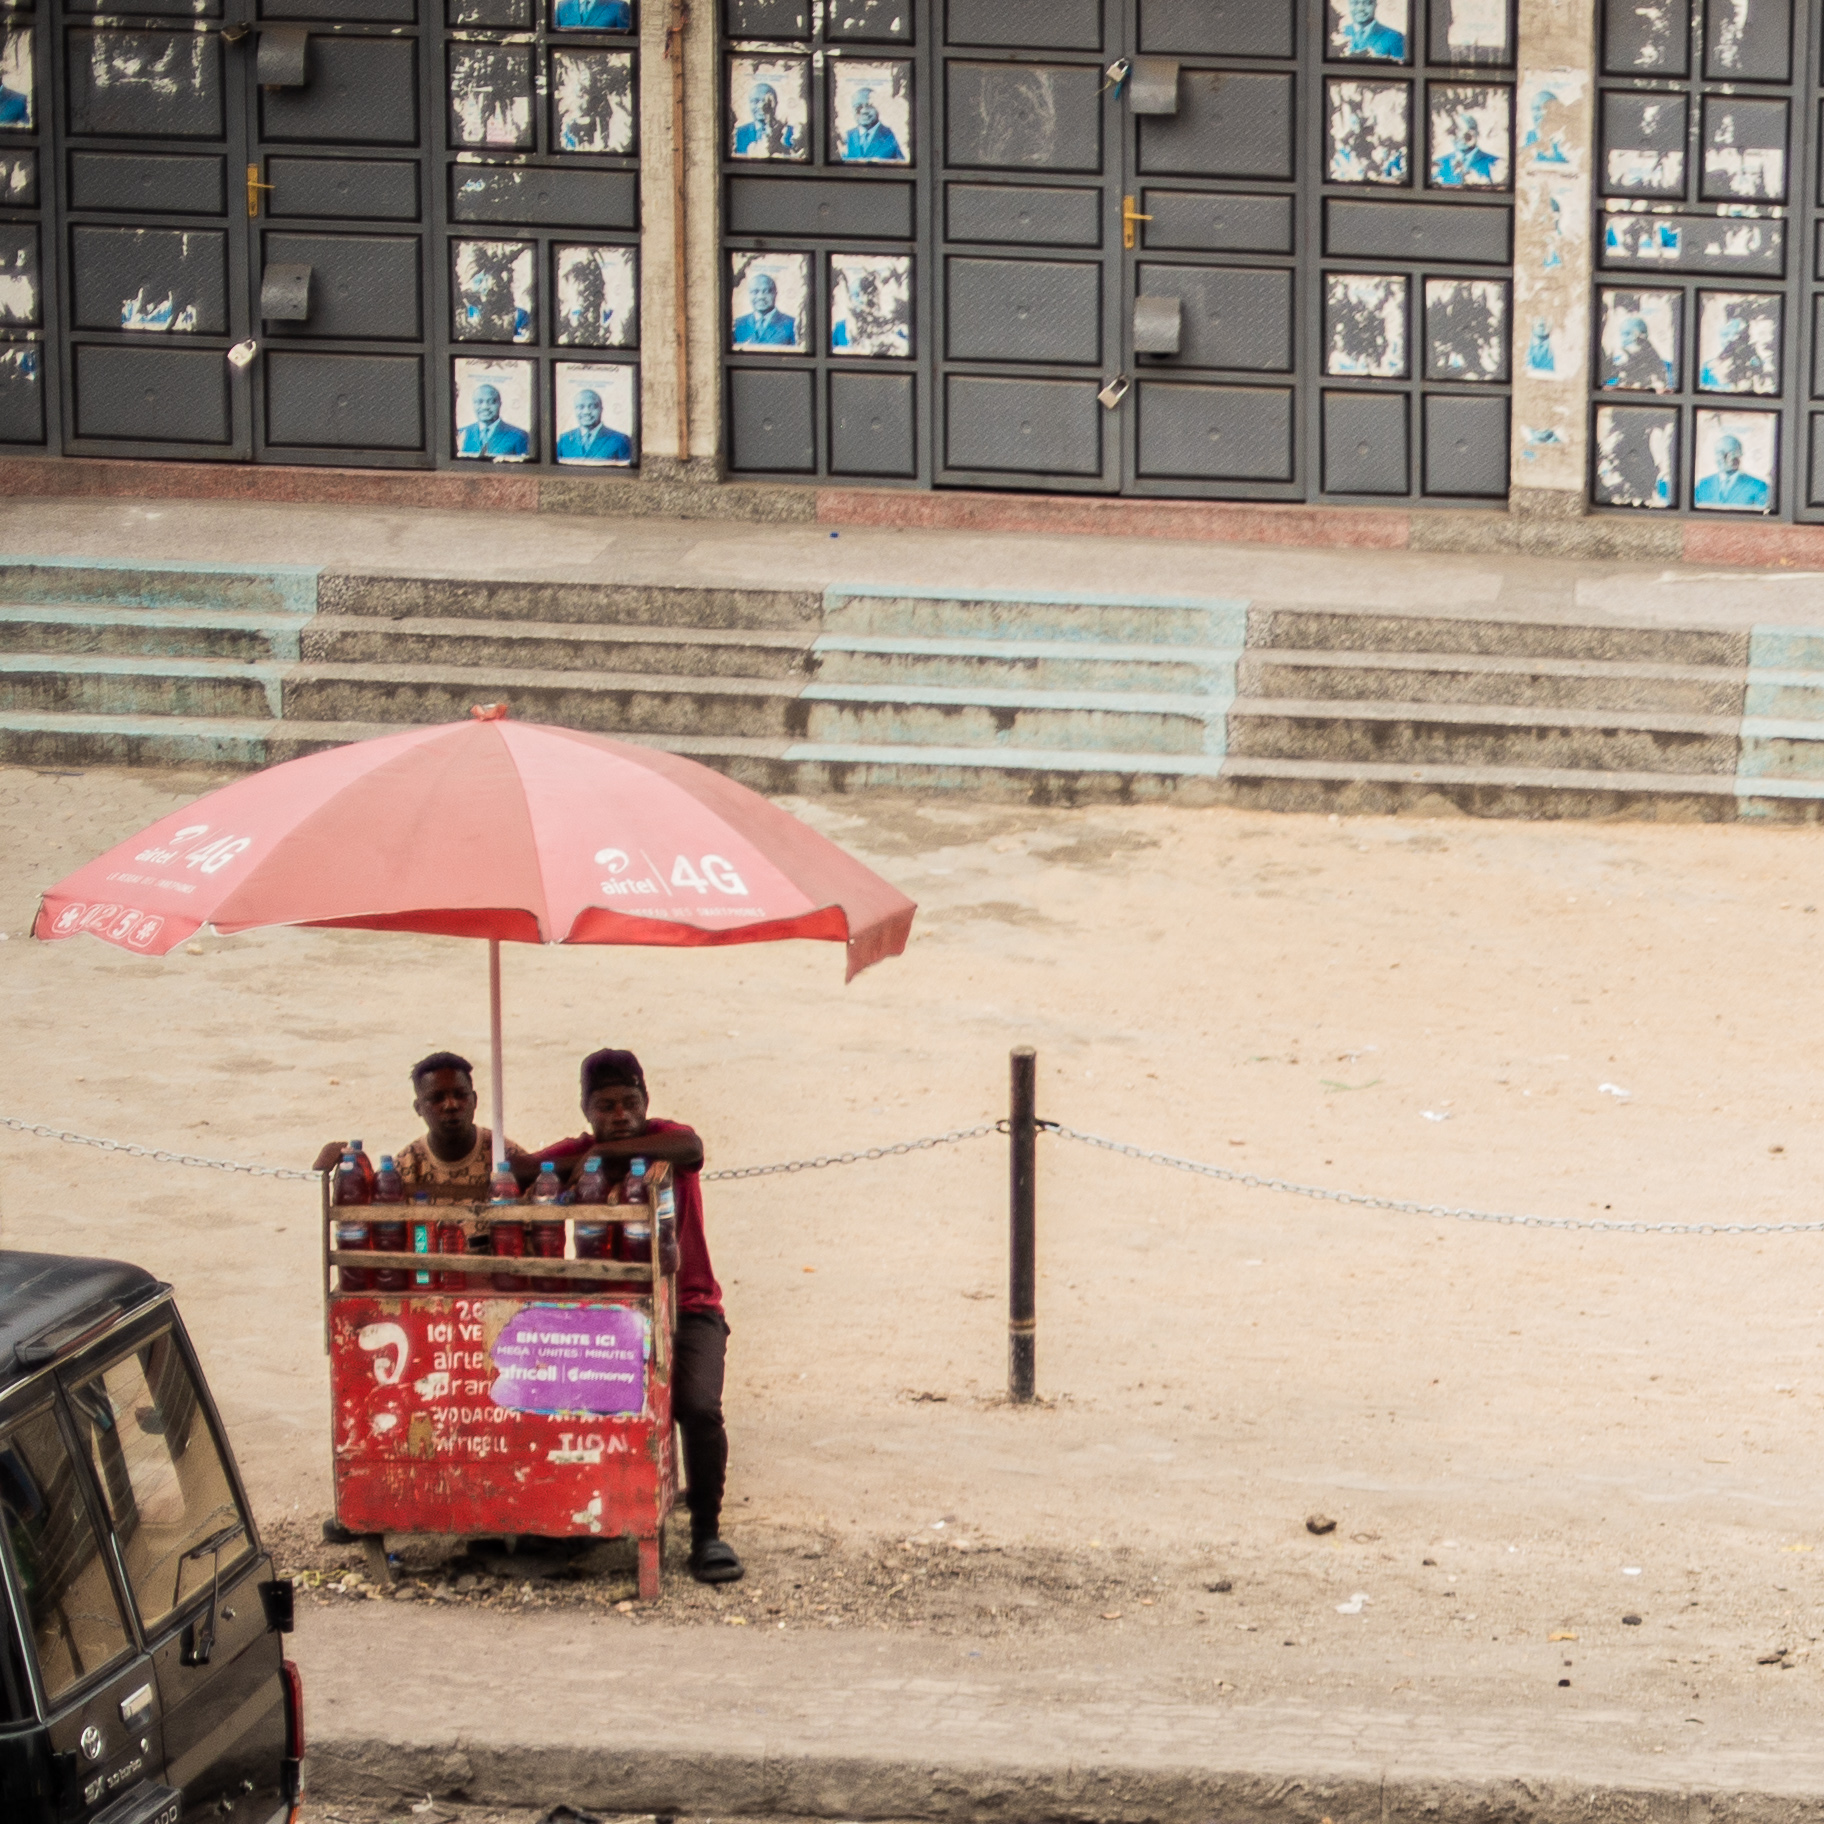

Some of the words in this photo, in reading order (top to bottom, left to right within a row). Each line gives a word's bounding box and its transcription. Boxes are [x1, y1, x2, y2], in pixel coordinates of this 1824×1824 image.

[185, 834, 252, 874] 4G
[600, 877, 659, 896] airtel
[670, 853, 749, 896] 4G
[427, 1323, 453, 1343] ICI
[516, 1331, 538, 1344] EN
[539, 1332, 591, 1346] VENTE
[595, 1334, 616, 1347] ICI
[496, 1345, 531, 1356] MEGA
[538, 1347, 579, 1358] UNITES
[585, 1349, 635, 1361] MINUTES
